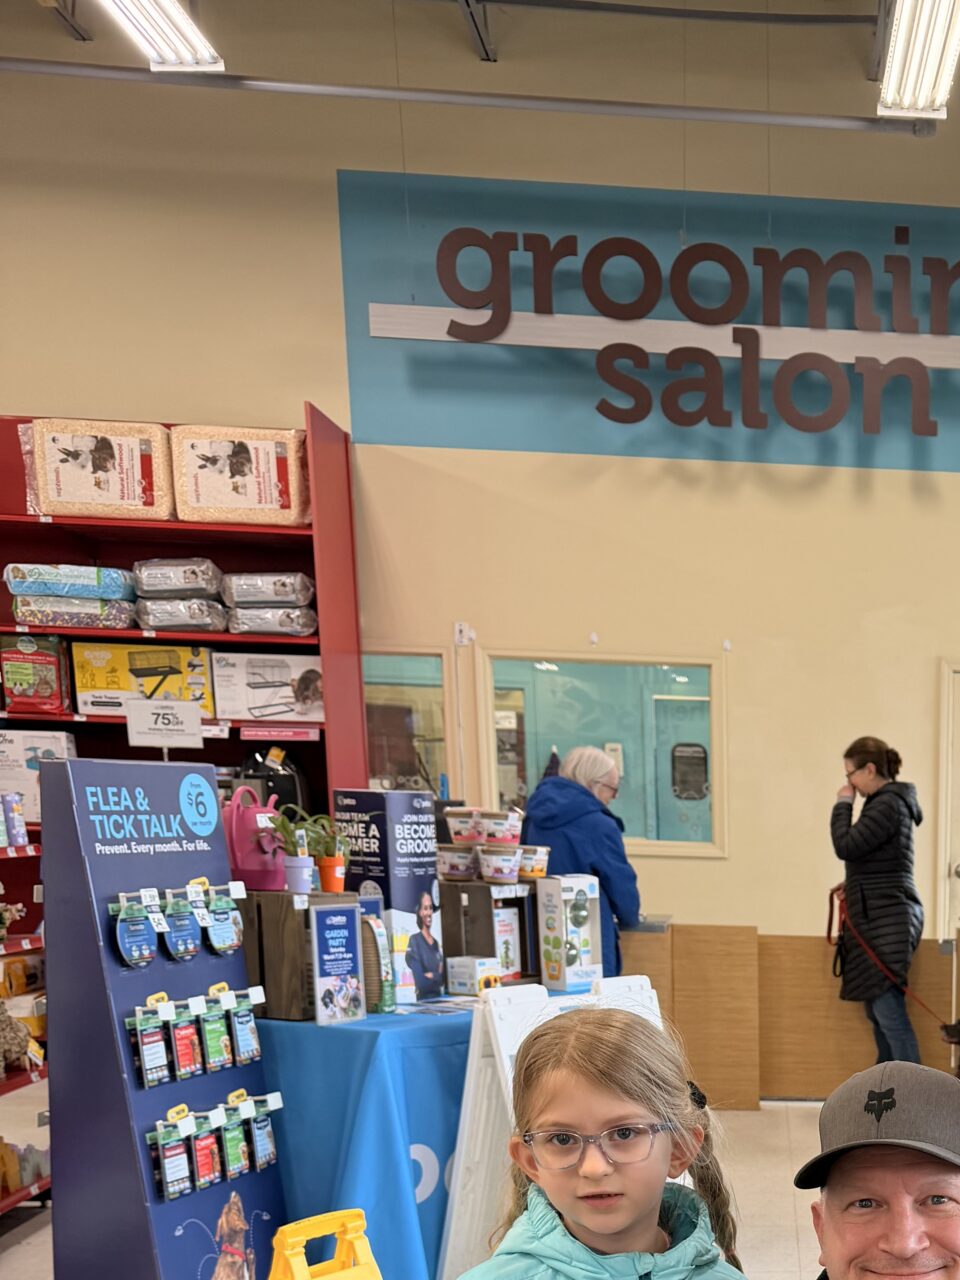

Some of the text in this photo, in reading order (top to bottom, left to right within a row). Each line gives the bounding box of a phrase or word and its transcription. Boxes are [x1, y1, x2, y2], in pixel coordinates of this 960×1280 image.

[595, 326, 938, 437] salon
[85, 786, 150, 811] FLEA &
[186, 791, 208, 819] $6
[89, 814, 186, 839] TICK TALK
[368, 824, 380, 838] A
[95, 840, 212, 856] Prevent. Every month. For life.
[325, 929, 349, 939] GARDEN
[328, 939, 346, 947] PARTY
